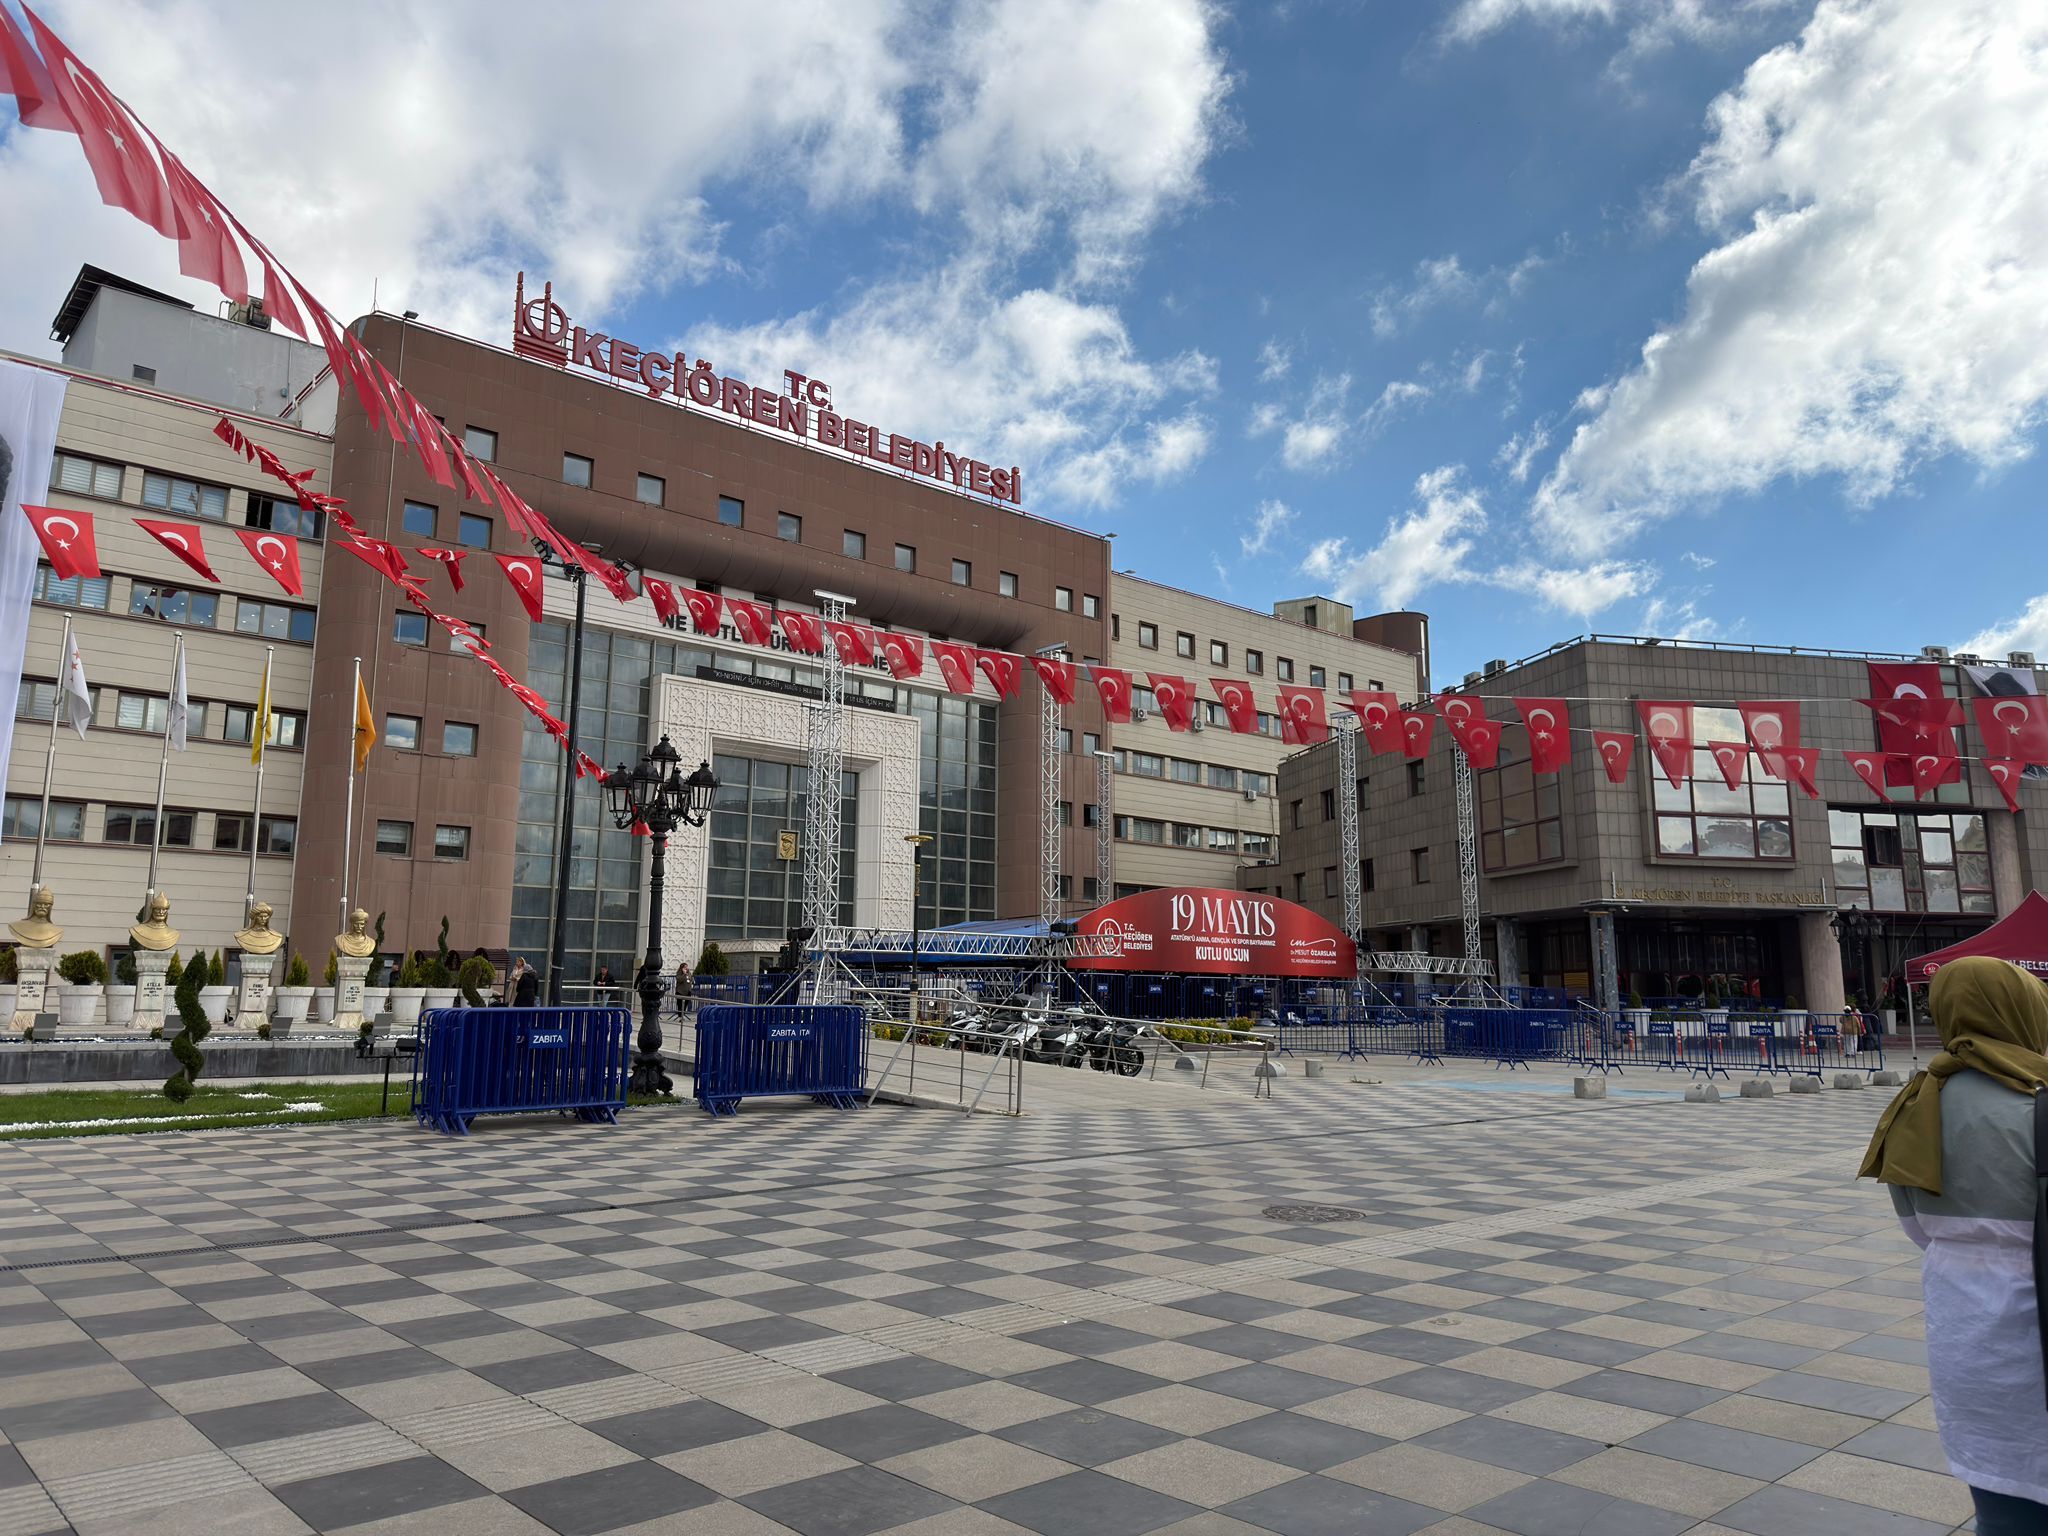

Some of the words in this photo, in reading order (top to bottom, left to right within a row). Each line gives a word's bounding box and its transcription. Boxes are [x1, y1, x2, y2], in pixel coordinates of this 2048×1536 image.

[784, 369, 833, 411] T.C.
[572, 325, 808, 437] KEÇİÖREN
[817, 409, 1021, 504] BELEDİYESİ
[1170, 894, 1196, 932] 19
[1201, 896, 1276, 937] MAYIS
[1123, 931, 1153, 942] KEÇİÖREN
[1123, 942, 1153, 951] BELEDİYESİ
[1195, 946, 1222, 960] KUTLU
[1223, 947, 1250, 962] OLSUN
[532, 1034, 564, 1044] ZABITA
[771, 1029, 797, 1037] ZABITA
